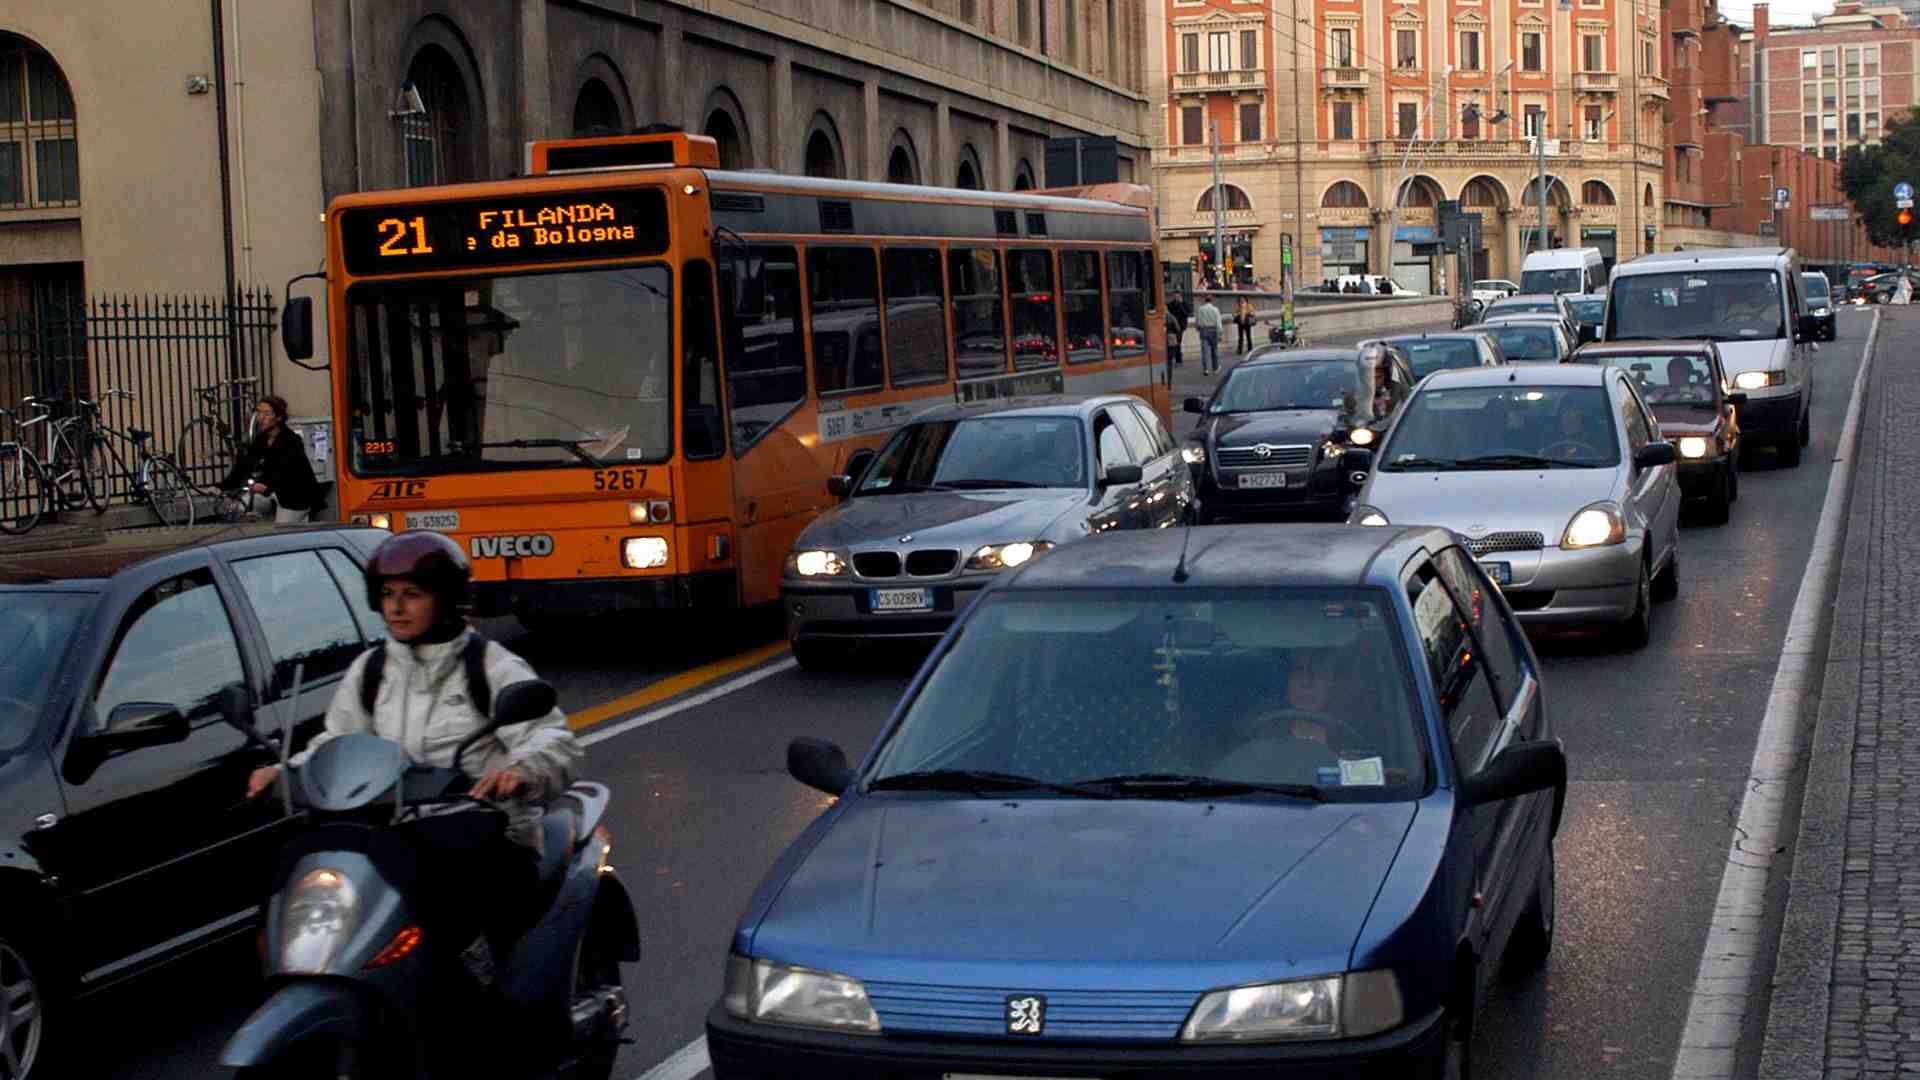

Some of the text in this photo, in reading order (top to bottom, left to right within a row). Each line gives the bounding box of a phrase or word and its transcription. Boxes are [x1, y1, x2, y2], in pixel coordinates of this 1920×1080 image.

[479, 203, 615, 229] FILANDA
[377, 216, 433, 256] 21
[491, 231, 520, 248] da
[534, 224, 635, 246] Bologna
[593, 469, 648, 491] 5267
[470, 534, 553, 558] IVECO
